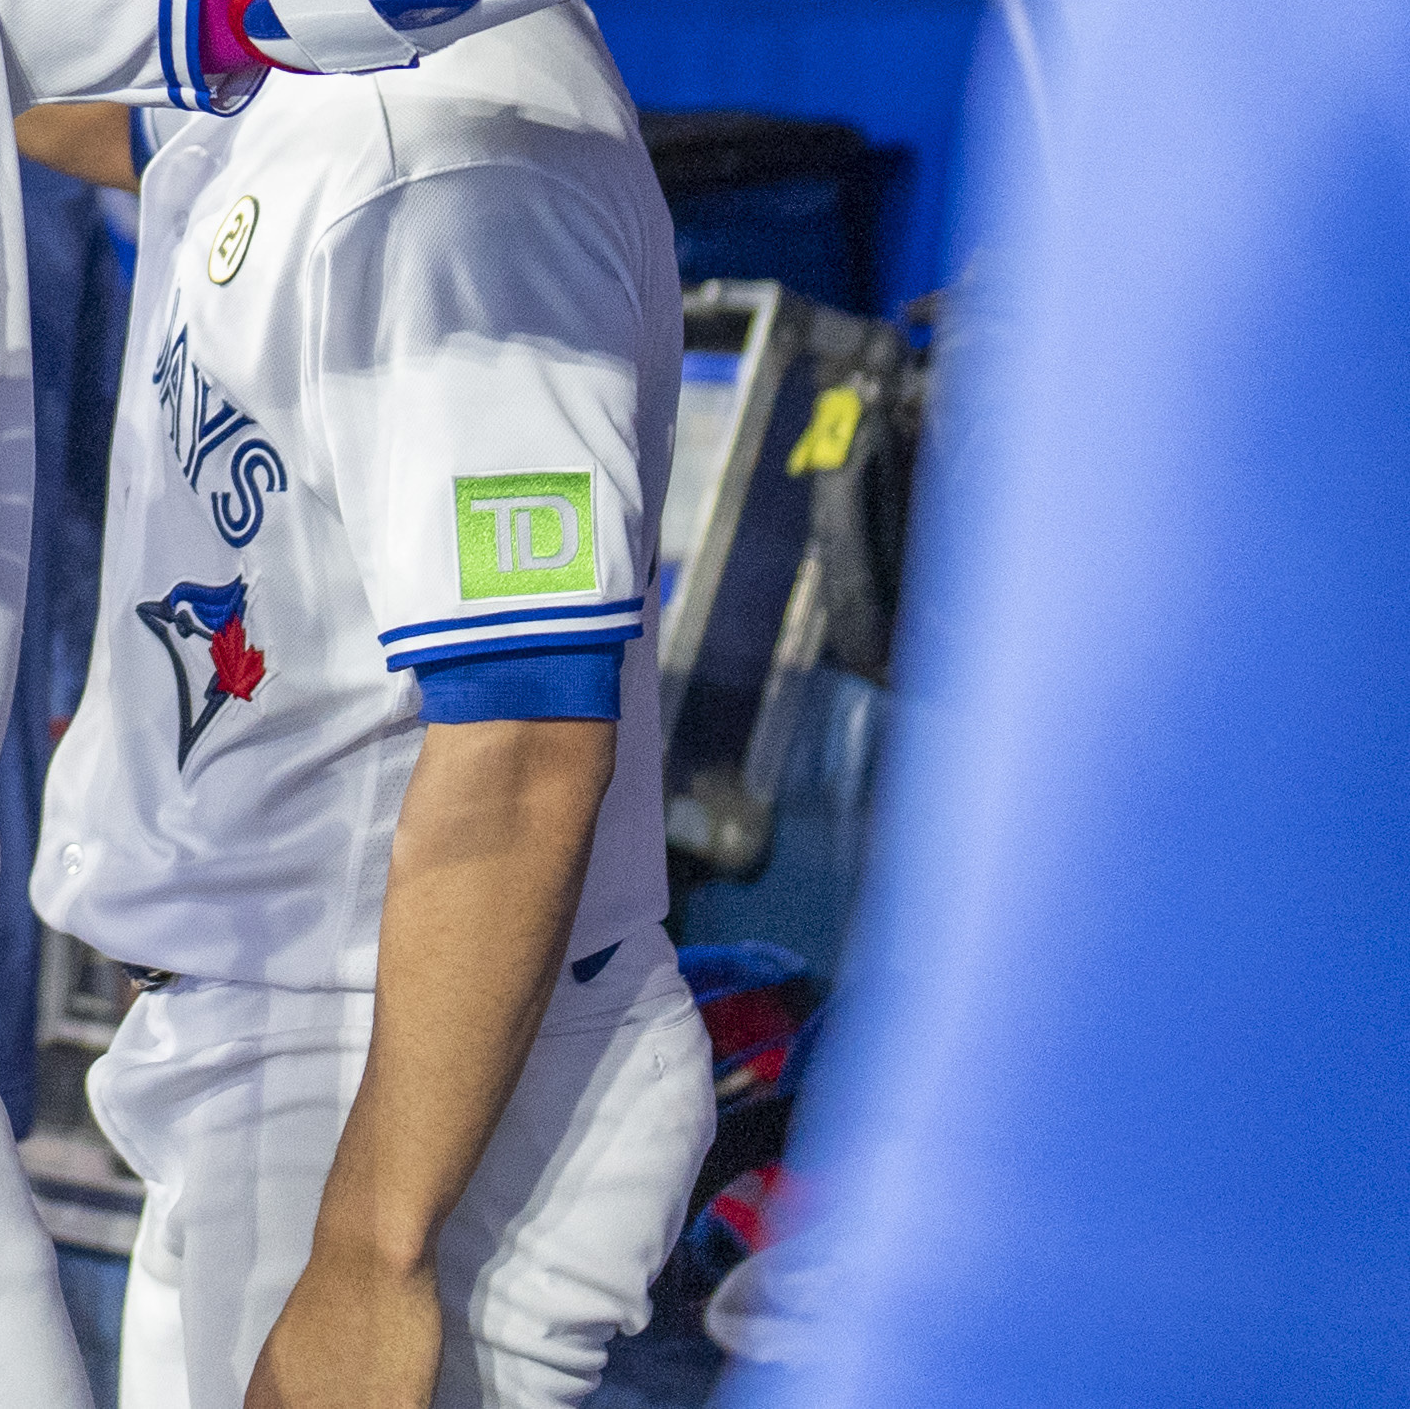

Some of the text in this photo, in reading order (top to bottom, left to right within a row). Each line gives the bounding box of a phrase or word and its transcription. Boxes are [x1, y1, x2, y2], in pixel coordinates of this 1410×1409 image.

[218, 212, 249, 268] 21
[152, 287, 288, 548] JAYS
[471, 495, 579, 573] TD
